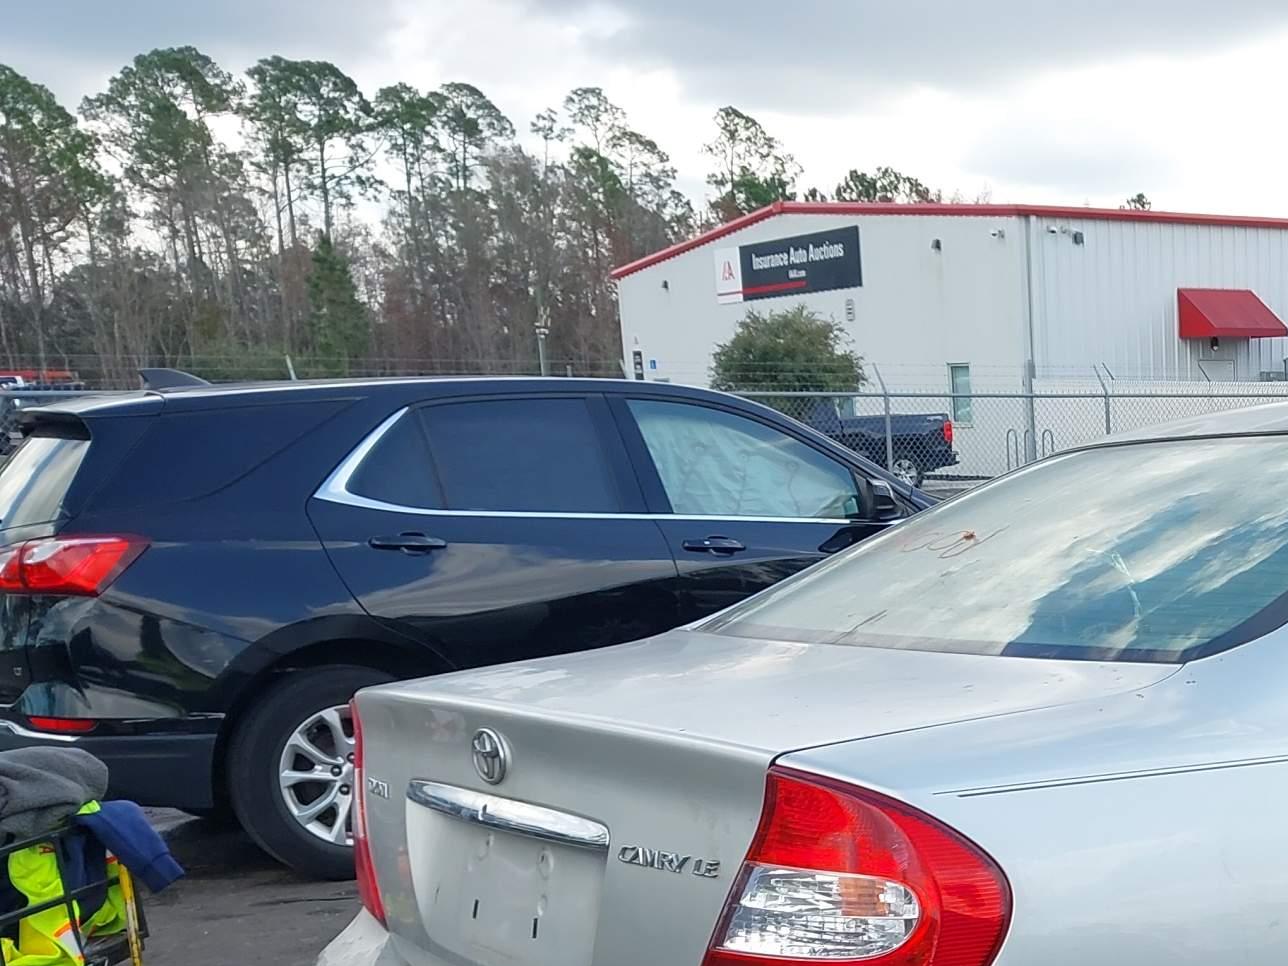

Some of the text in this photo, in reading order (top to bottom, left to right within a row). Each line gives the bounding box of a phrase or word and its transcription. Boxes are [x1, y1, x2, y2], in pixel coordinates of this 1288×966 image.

[751, 240, 845, 270] Insurance Auto Auctions
[617, 845, 721, 879] CAMRY LE
